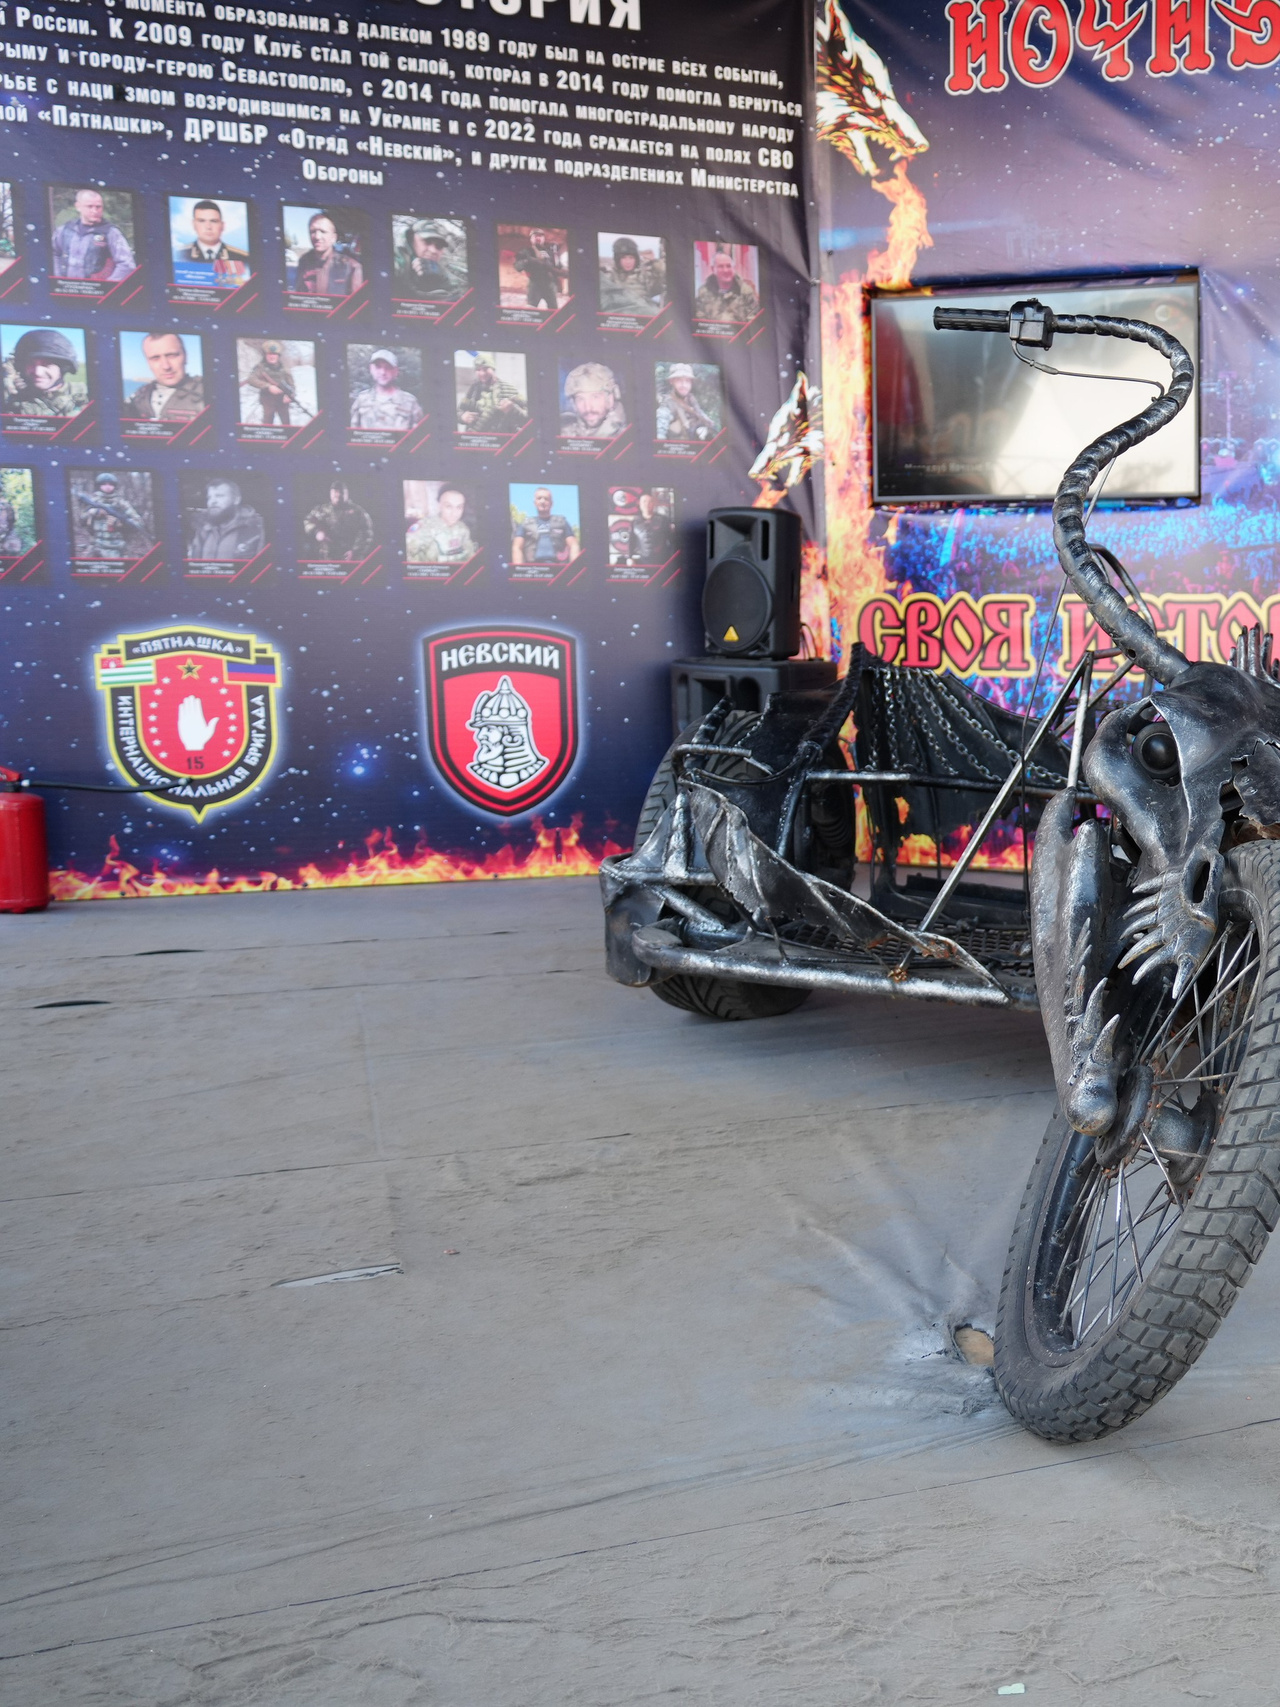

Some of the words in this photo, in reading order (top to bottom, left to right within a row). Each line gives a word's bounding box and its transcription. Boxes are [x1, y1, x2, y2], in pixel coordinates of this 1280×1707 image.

[441, 27, 491, 52] 1989
[108, 17, 124, 39] К
[133, 20, 192, 47] 2009
[556, 69, 604, 94] 2014
[381, 78, 433, 103] 2014
[184, 117, 268, 145] ДРШБР
[484, 118, 536, 143] 2022
[758, 147, 793, 169] СВО
[856, 597, 1031, 673] СВОЯ
[441, 642, 560, 671] НЕВСКИЙ
[243, 694, 267, 766] БРИГАДА
[187, 756, 205, 770] 15
